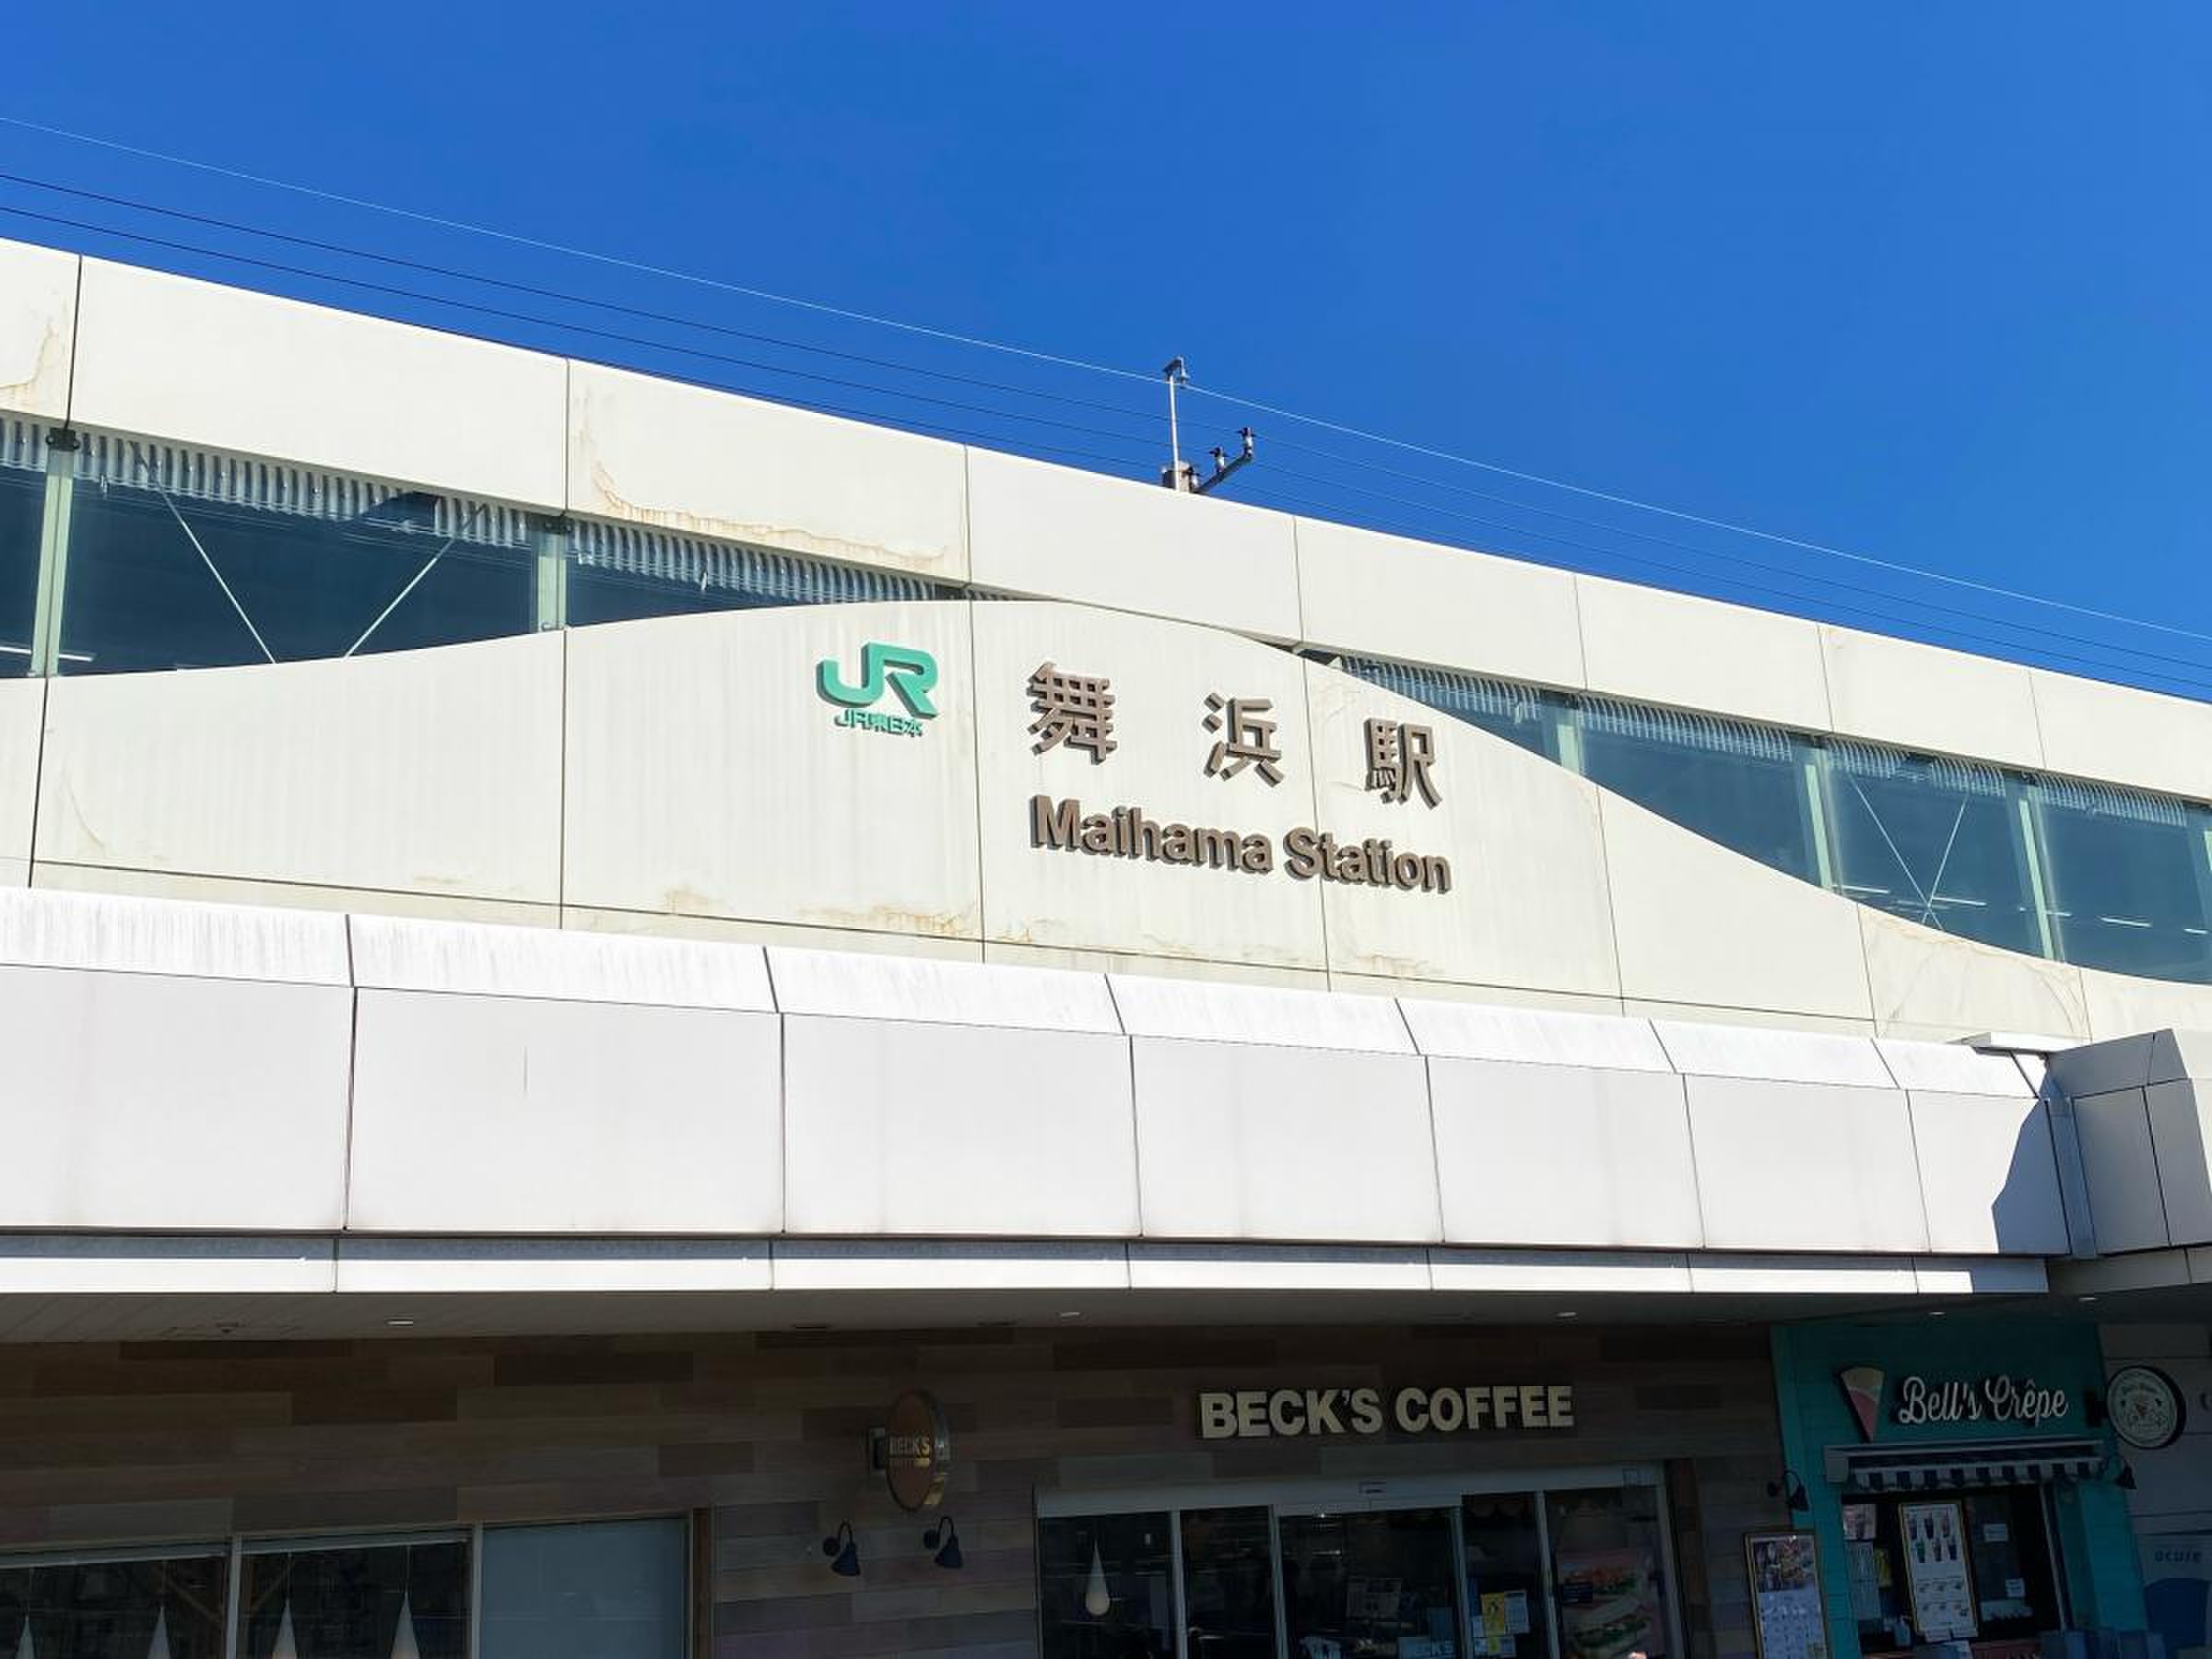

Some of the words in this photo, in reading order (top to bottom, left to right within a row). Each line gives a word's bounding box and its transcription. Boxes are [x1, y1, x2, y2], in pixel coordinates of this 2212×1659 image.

[816, 641, 939, 720] JR
[1026, 662, 1441, 810] 舞浜駅
[1030, 794, 1274, 874] Maihama
[1283, 827, 1453, 893] Station
[1199, 1388, 1382, 1440] BECK'S
[1394, 1385, 1575, 1433] COFFEE
[1897, 1375, 1983, 1425] Bell's
[1984, 1373, 2070, 1428] Crêpe
